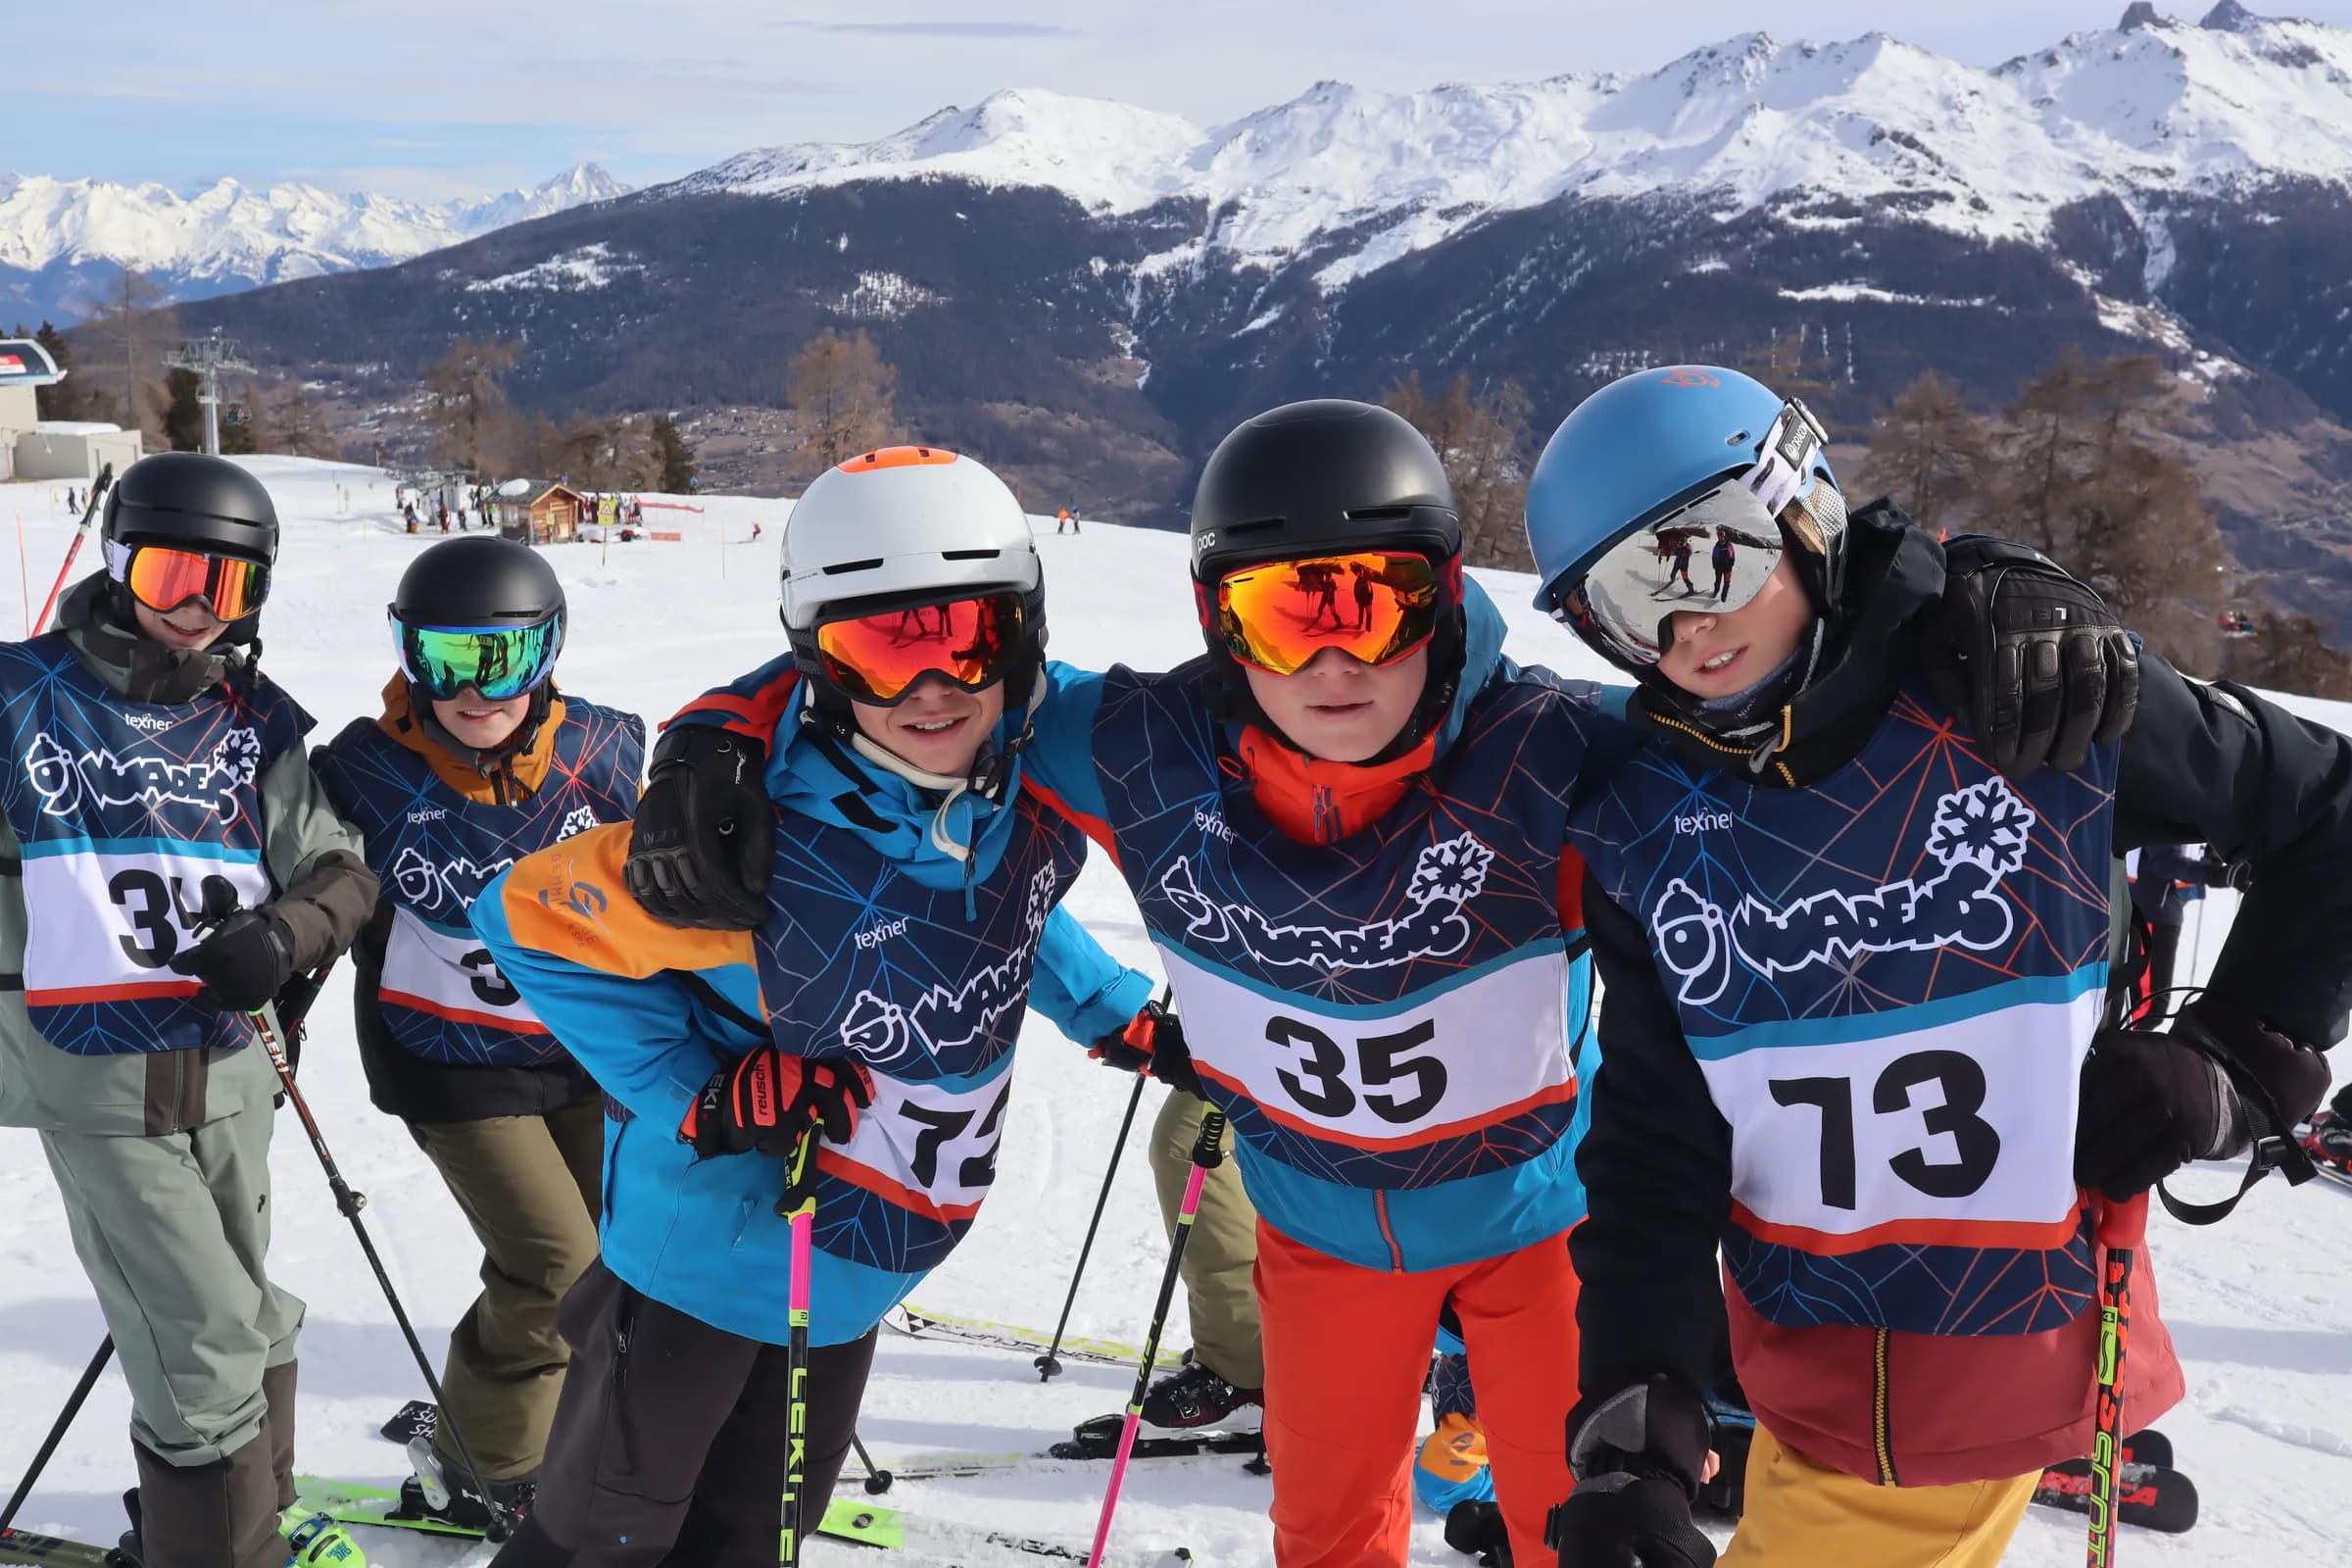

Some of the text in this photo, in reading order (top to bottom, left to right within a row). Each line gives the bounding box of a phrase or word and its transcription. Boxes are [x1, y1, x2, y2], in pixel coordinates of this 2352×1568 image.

[124, 712, 173, 731] texner
[855, 916, 909, 951] texner
[703, 1073, 724, 1109] EKI
[755, 1064, 768, 1115] reusch
[1265, 1015, 1448, 1125] 35
[1768, 1050, 2002, 1211] 73
[788, 1368, 808, 1483] LEKI
